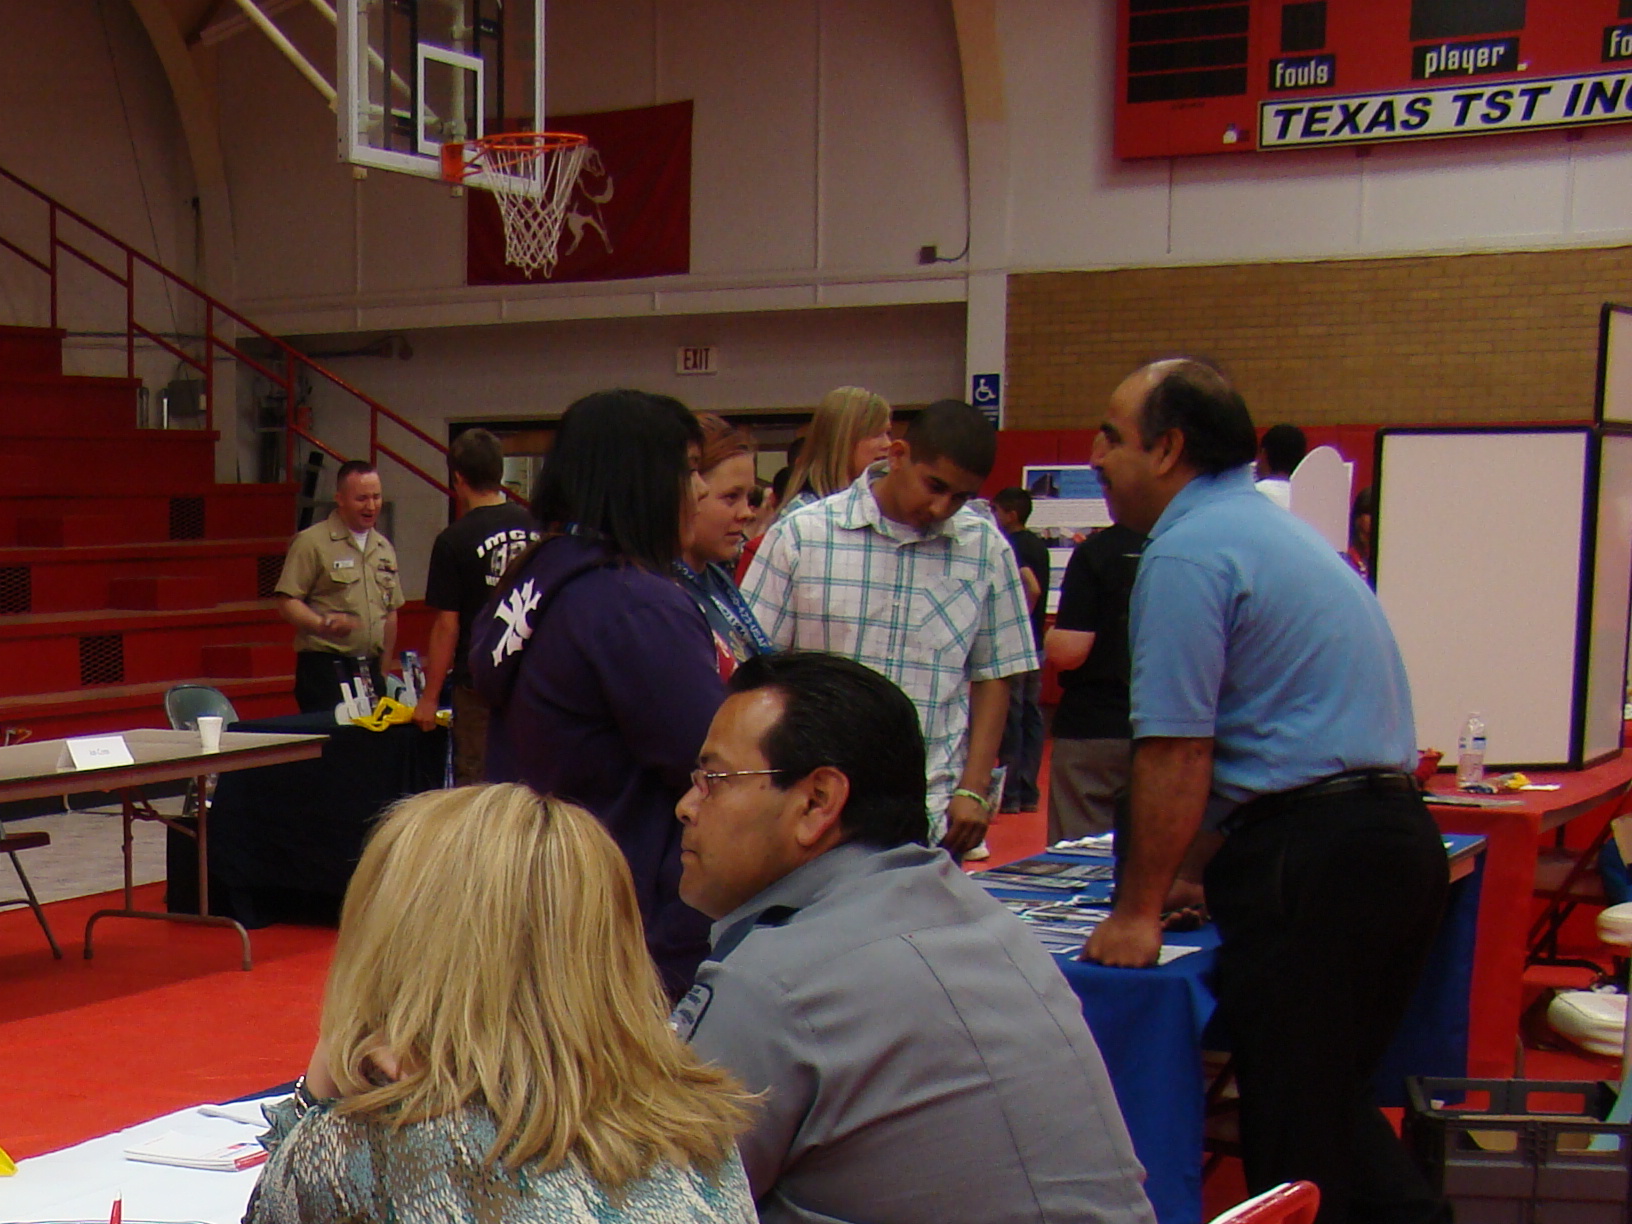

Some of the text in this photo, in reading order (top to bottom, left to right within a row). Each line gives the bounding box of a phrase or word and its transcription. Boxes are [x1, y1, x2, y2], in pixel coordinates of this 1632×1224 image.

[1275, 60, 1329, 88] fouls
[1424, 44, 1505, 78] player
[1272, 97, 1431, 141] TEXAS
[1451, 86, 1552, 127] TST
[684, 348, 710, 370] EXIT
